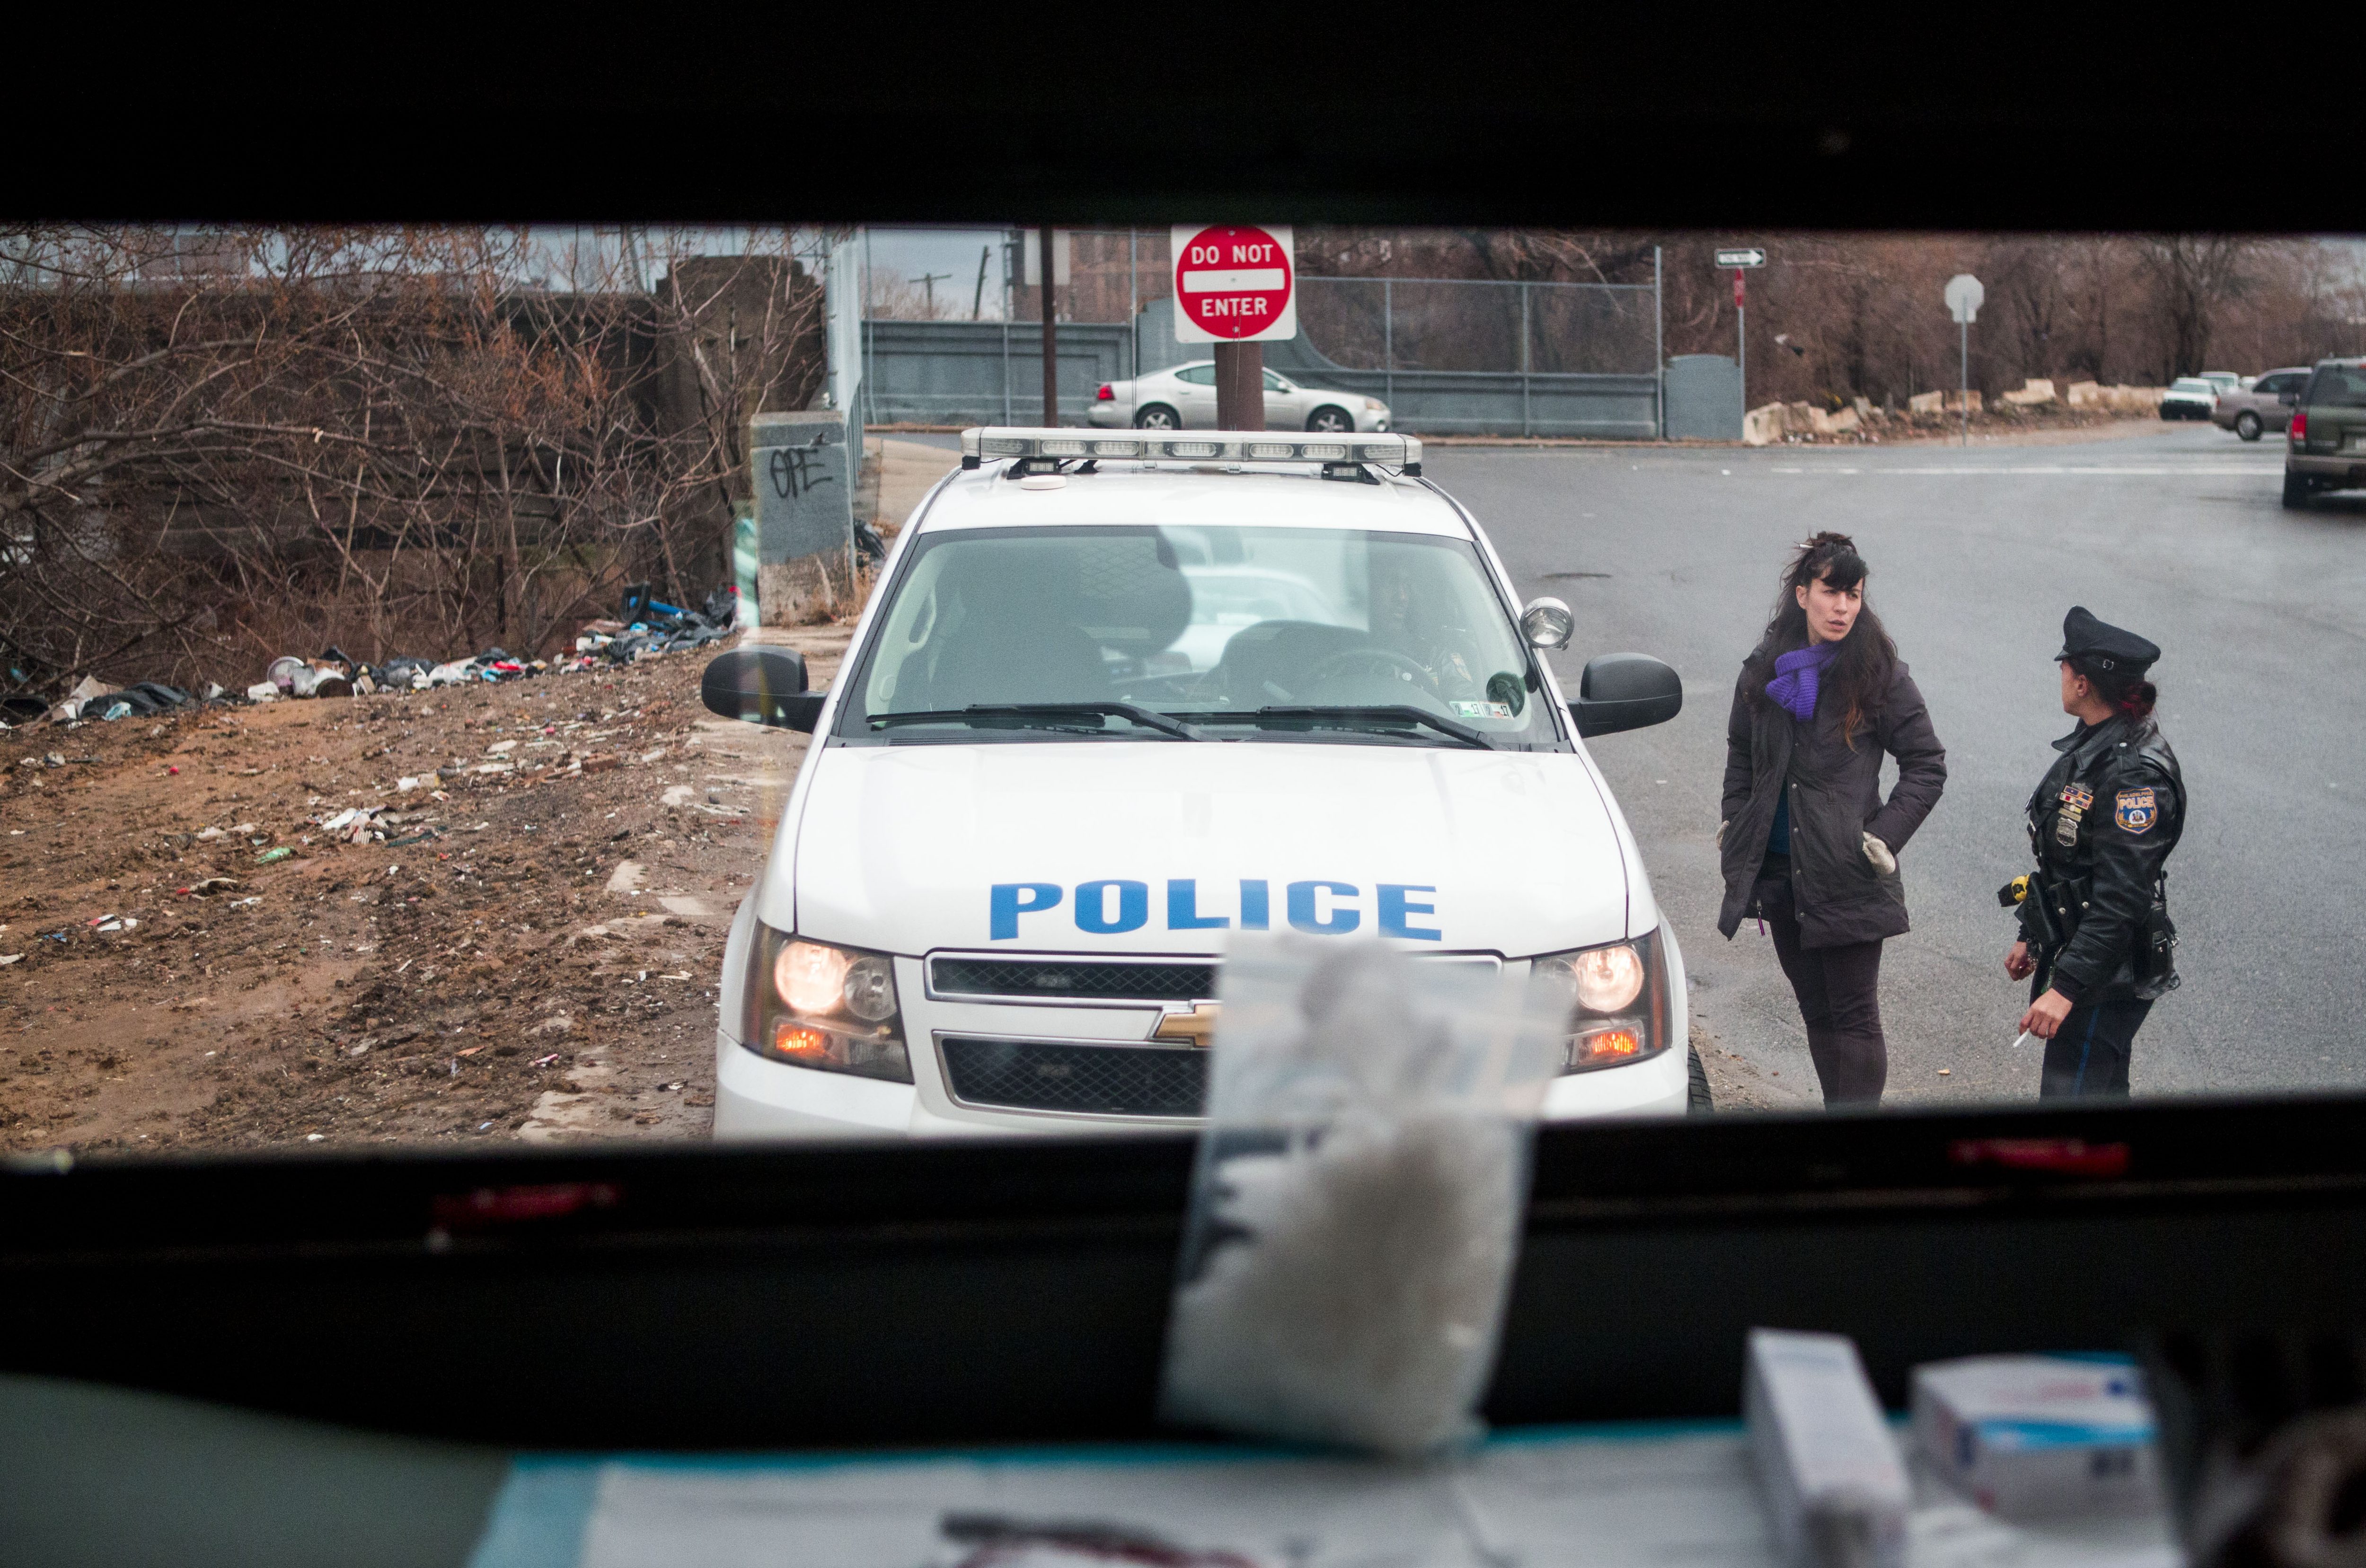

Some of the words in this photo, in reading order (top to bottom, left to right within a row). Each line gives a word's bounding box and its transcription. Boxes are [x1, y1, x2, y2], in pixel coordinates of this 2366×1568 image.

[1191, 246, 1219, 264] DO
[1232, 244, 1273, 263] NOT
[1201, 297, 1268, 317] ENTER
[2119, 796, 2153, 810] POLICE
[990, 879, 1442, 942] POLICE
